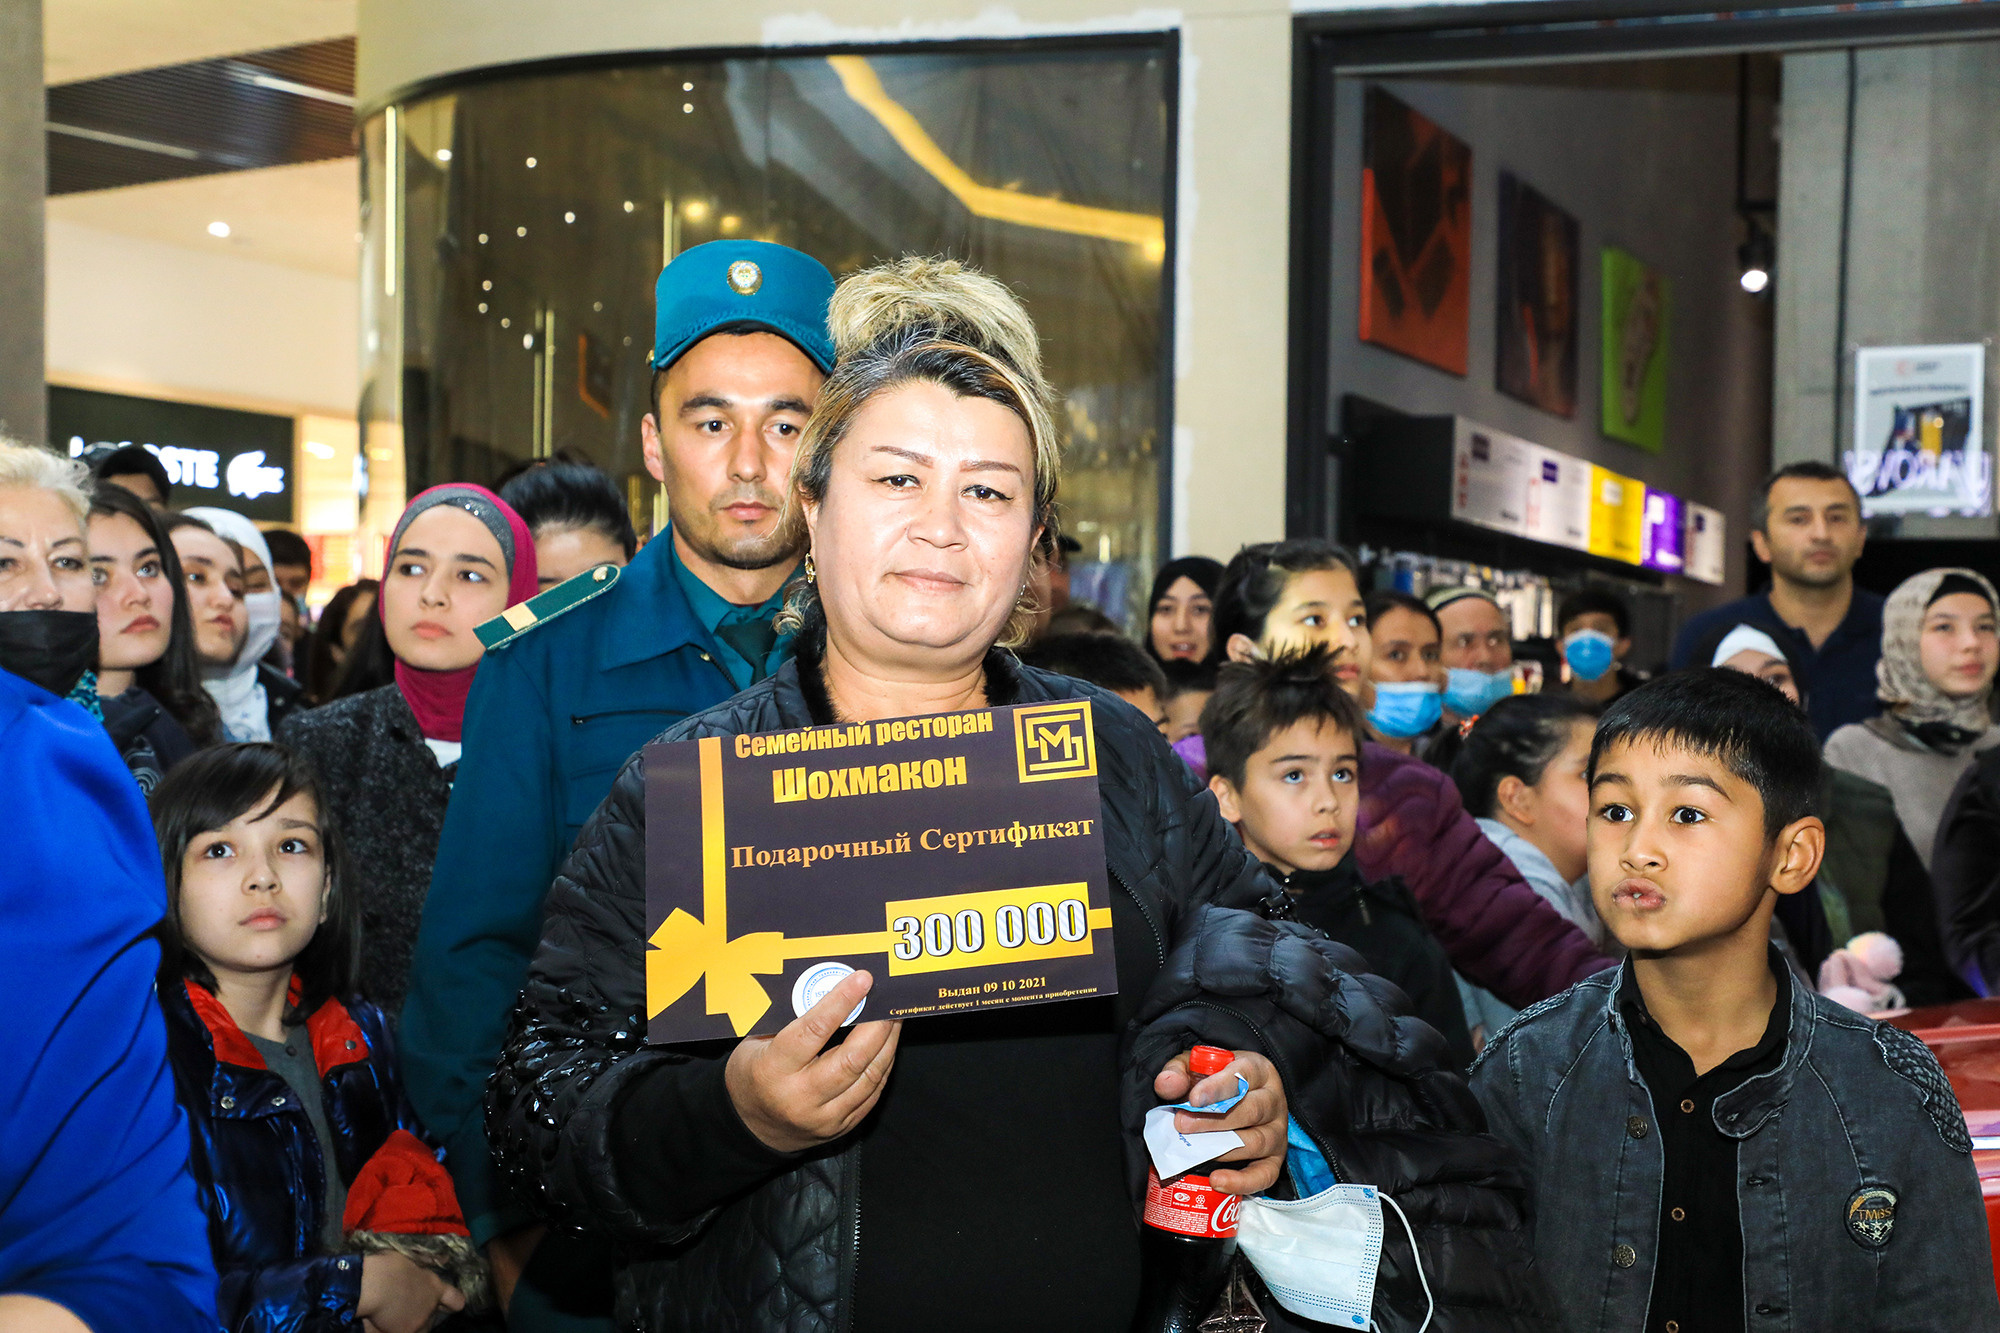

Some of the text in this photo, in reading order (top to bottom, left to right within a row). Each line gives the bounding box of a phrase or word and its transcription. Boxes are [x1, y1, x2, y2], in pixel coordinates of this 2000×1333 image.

[735, 712, 993, 758] Семейный ресторан
[772, 756, 968, 803] Шохмакон
[731, 819, 1094, 868] Подарочный Сертификат
[893, 899, 1088, 961] 300 000
[889, 1005, 936, 1016] Сертификат
[938, 977, 1046, 998] Выдан 09 10 2021
